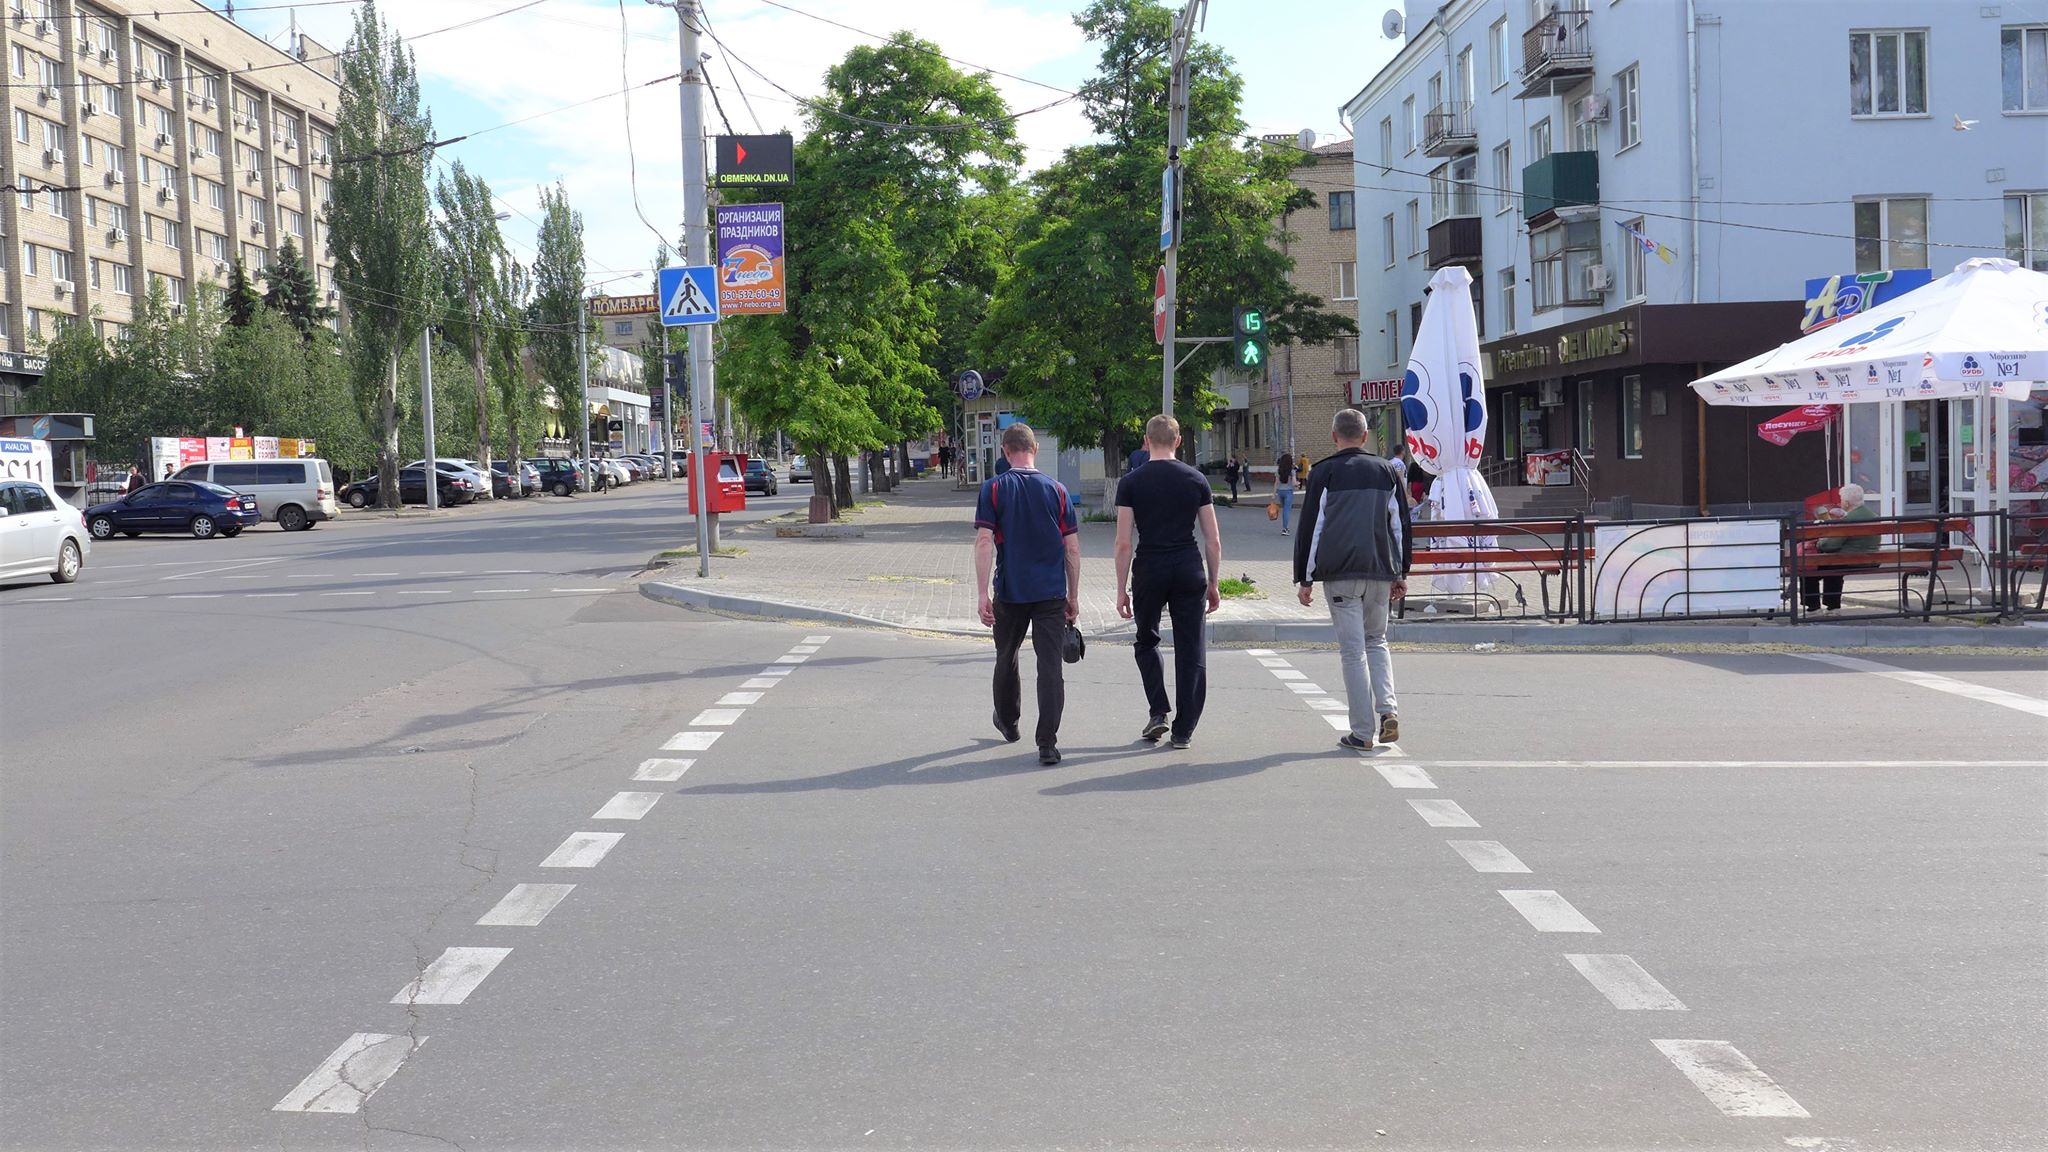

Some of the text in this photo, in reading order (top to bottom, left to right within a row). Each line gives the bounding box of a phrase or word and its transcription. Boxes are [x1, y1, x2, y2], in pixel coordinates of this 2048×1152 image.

[720, 174, 788, 182] OBMENKA.DN.UA
[718, 210, 781, 224] ОРГАНИЗАЦИЯ
[720, 225, 779, 240] ПРАЗДНИКОВ
[721, 289, 780, 300] 050-532-60-49
[593, 297, 655, 314] ЛОМБАРД
[1246, 313, 1261, 331] 15
[1997, 362, 2019, 376] №1
[4, 443, 29, 451] AVALON
